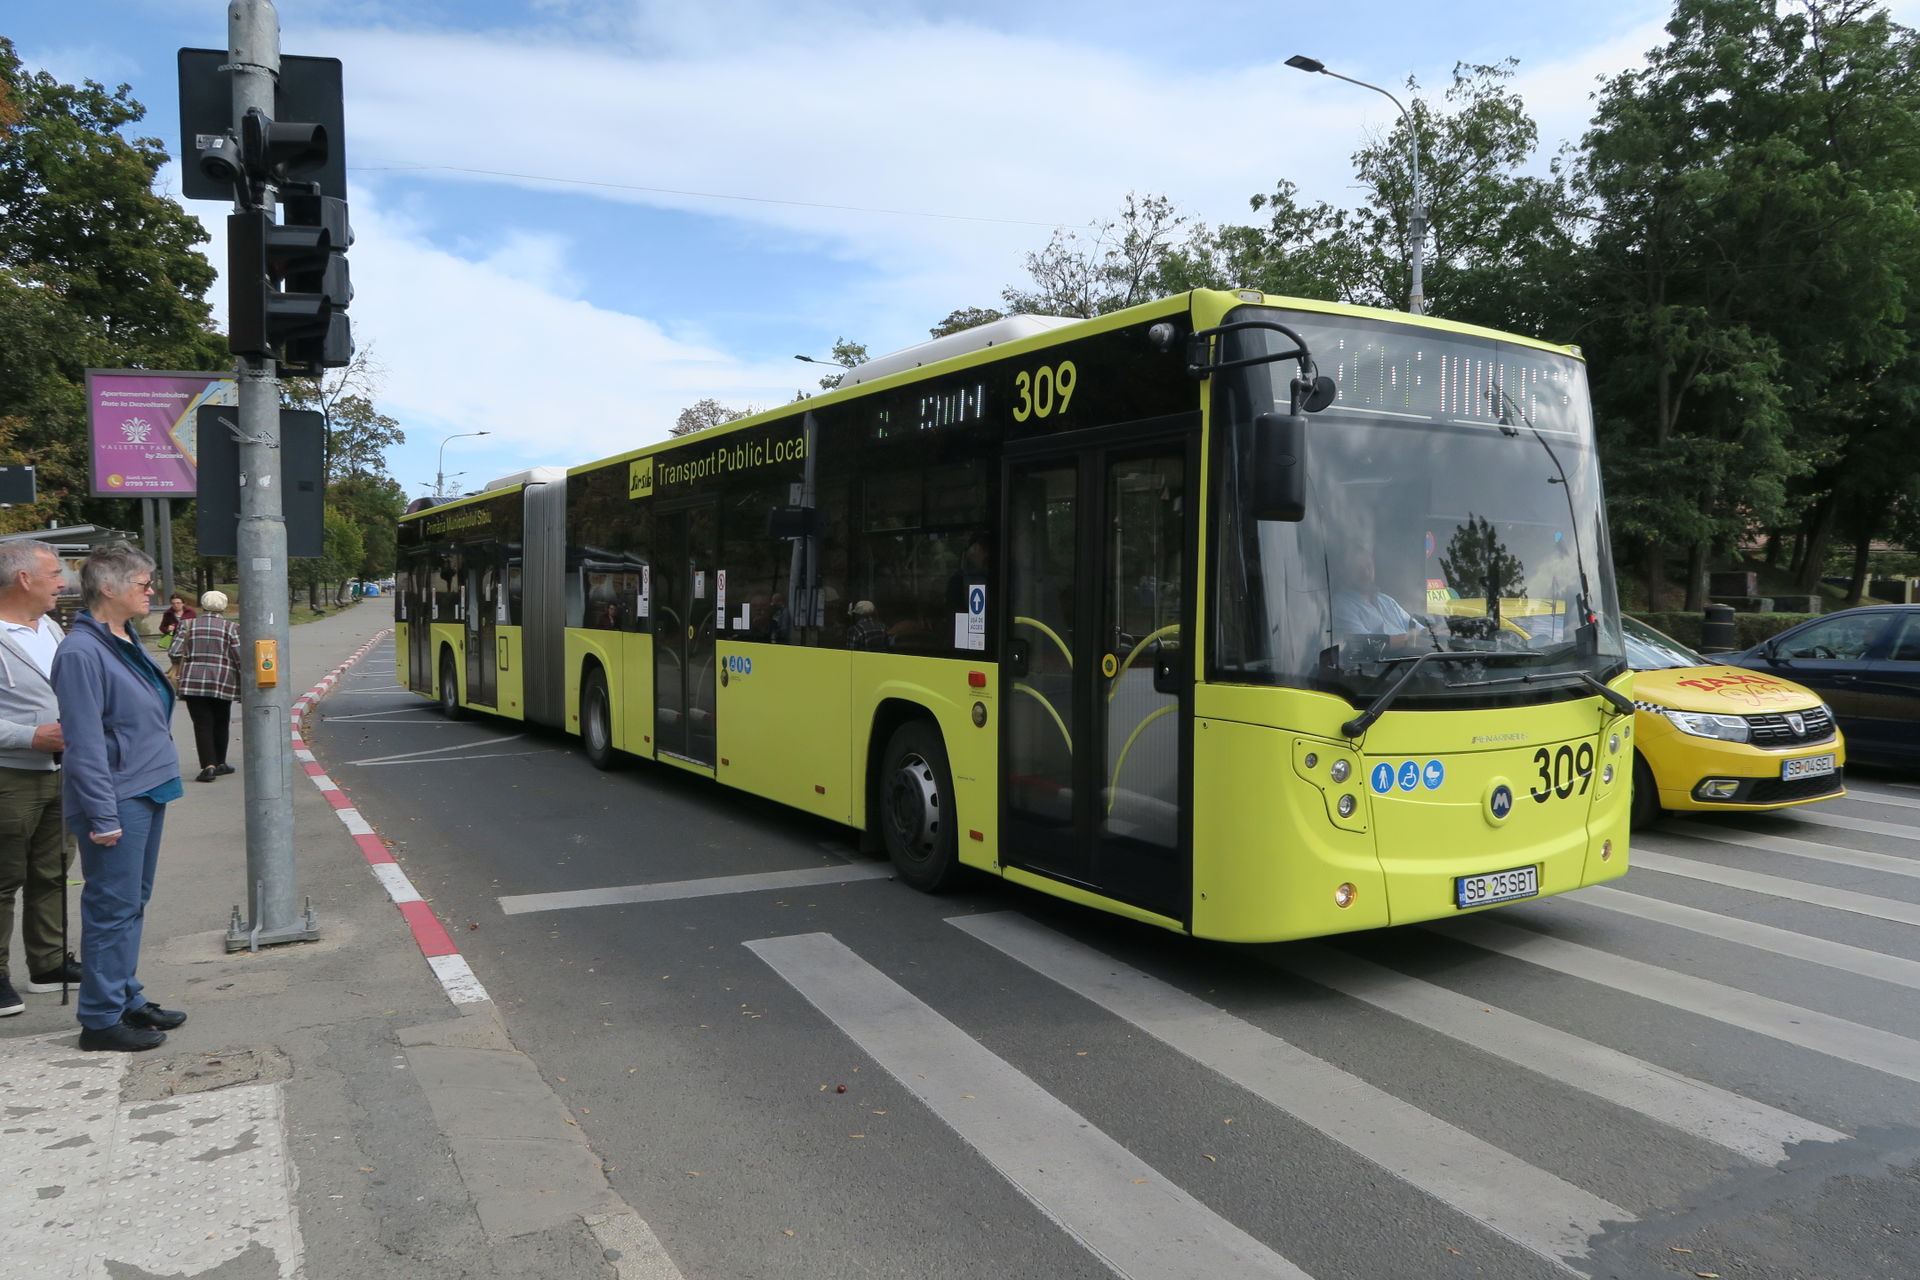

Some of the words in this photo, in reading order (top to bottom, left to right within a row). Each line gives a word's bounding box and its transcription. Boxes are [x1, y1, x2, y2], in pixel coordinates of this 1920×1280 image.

[1013, 360, 1077, 422] 309
[658, 451, 716, 486] Transport
[718, 442, 763, 474] Public
[765, 429, 810, 465] Local
[1427, 590, 1447, 601] TAXI
[1676, 675, 1781, 692] TAXI
[1530, 742, 1594, 804] 309
[1789, 761, 1801, 775] SB
[1493, 792, 1510, 810] M
[1466, 878, 1486, 900] SB
